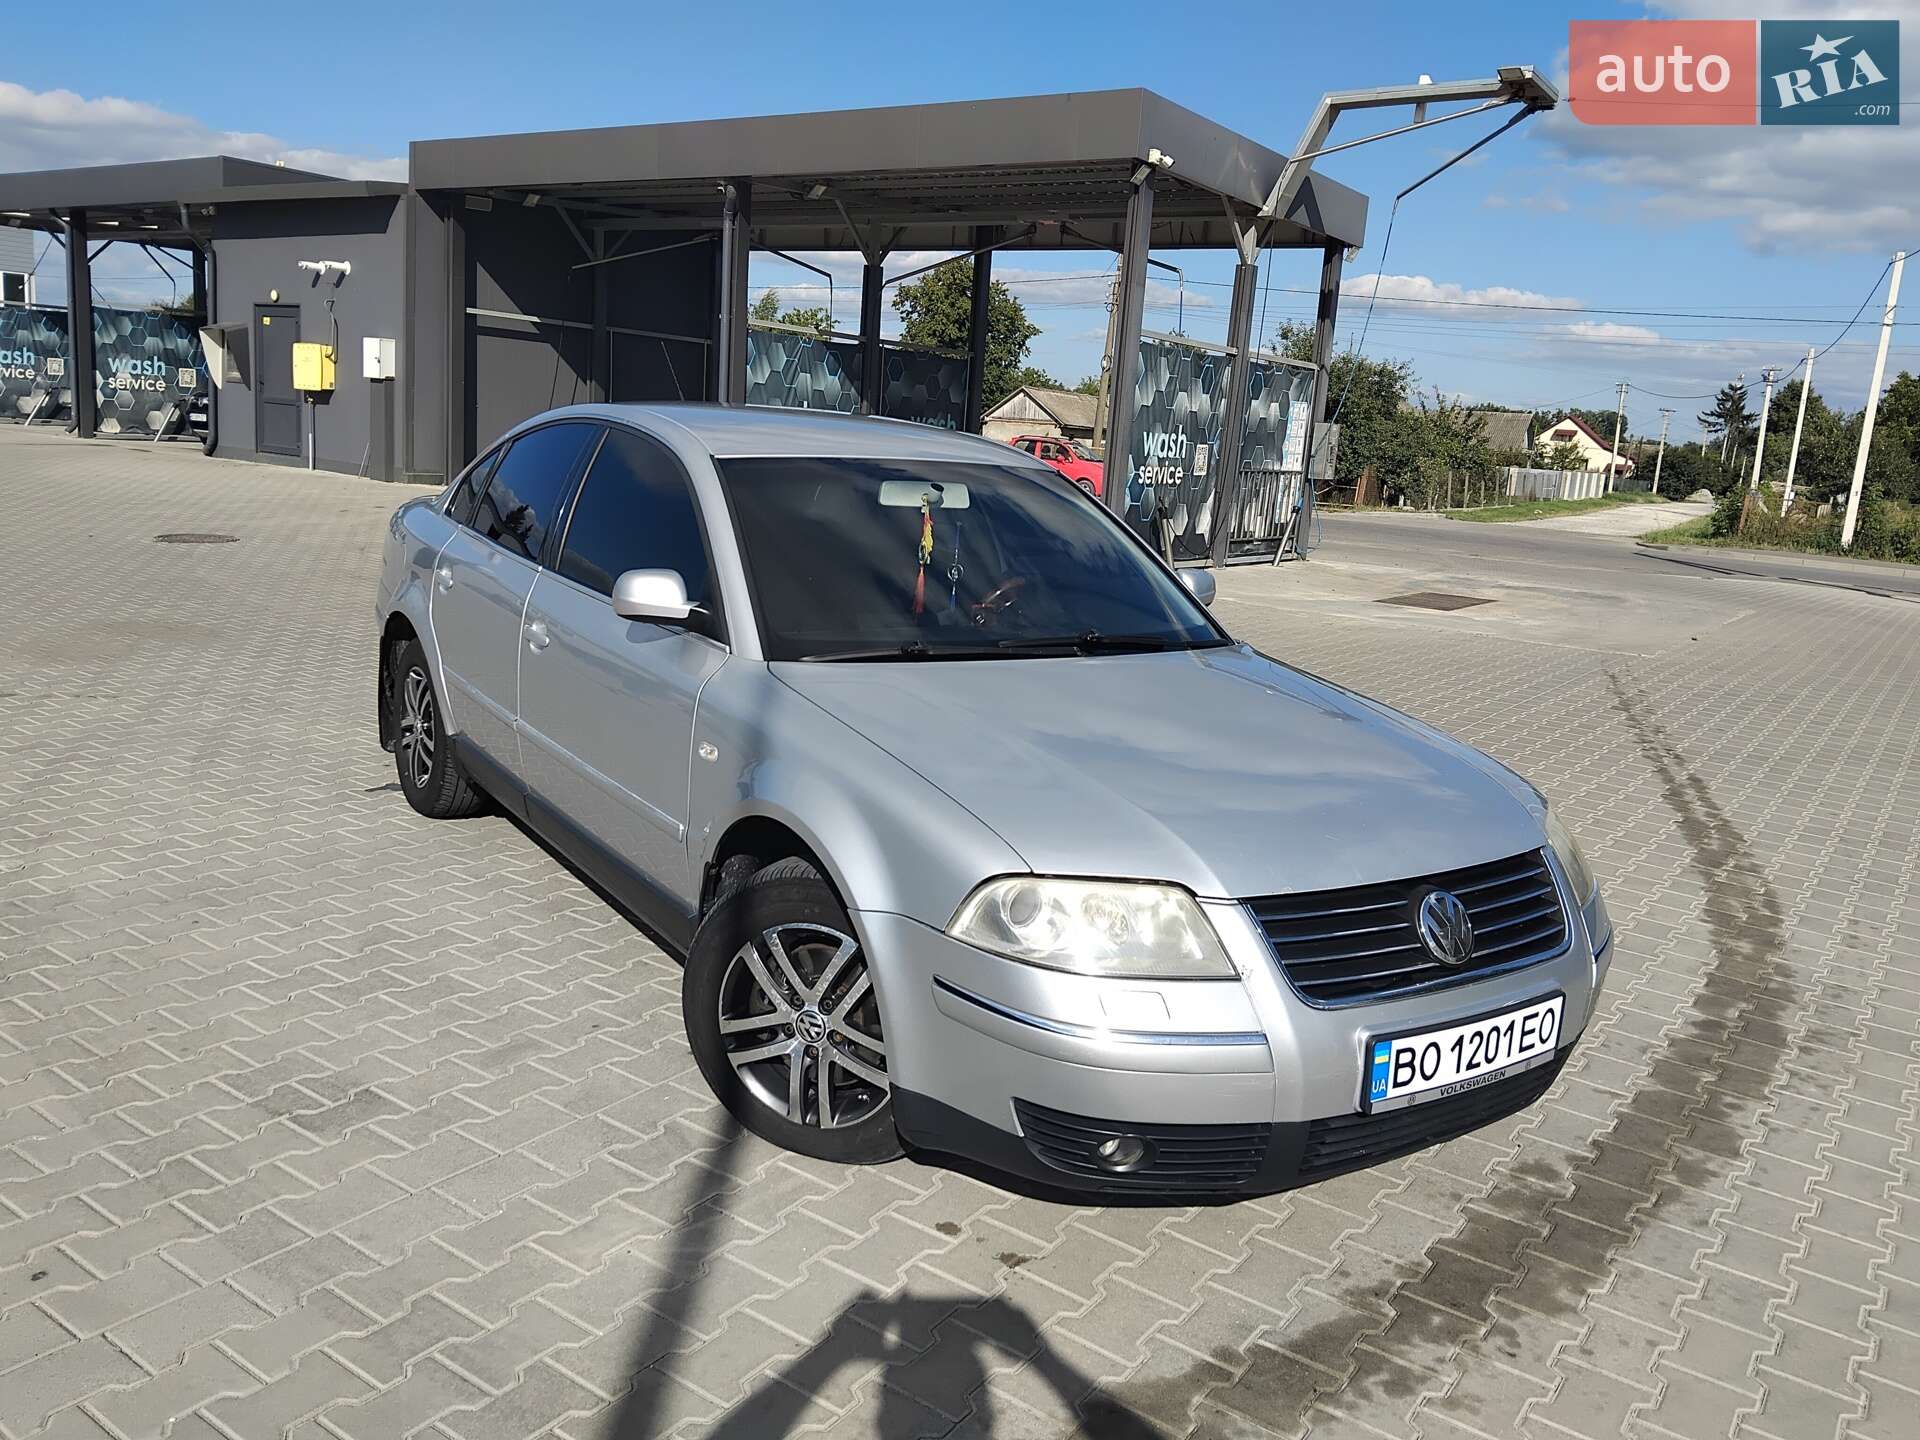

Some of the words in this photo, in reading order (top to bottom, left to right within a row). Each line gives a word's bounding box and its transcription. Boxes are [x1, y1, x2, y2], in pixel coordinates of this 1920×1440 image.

[0, 347, 35, 365] ash
[108, 356, 166, 376] wash
[0, 365, 35, 378] vice
[108, 376, 166, 392] service
[1143, 424, 1187, 459] wash
[1138, 461, 1184, 485] service
[1392, 1041, 1441, 1089] BO
[1450, 1018, 1516, 1074] 1201
[1372, 1080, 1387, 1093] UA
[1440, 1070, 1506, 1097] VOLKSWAGEN
